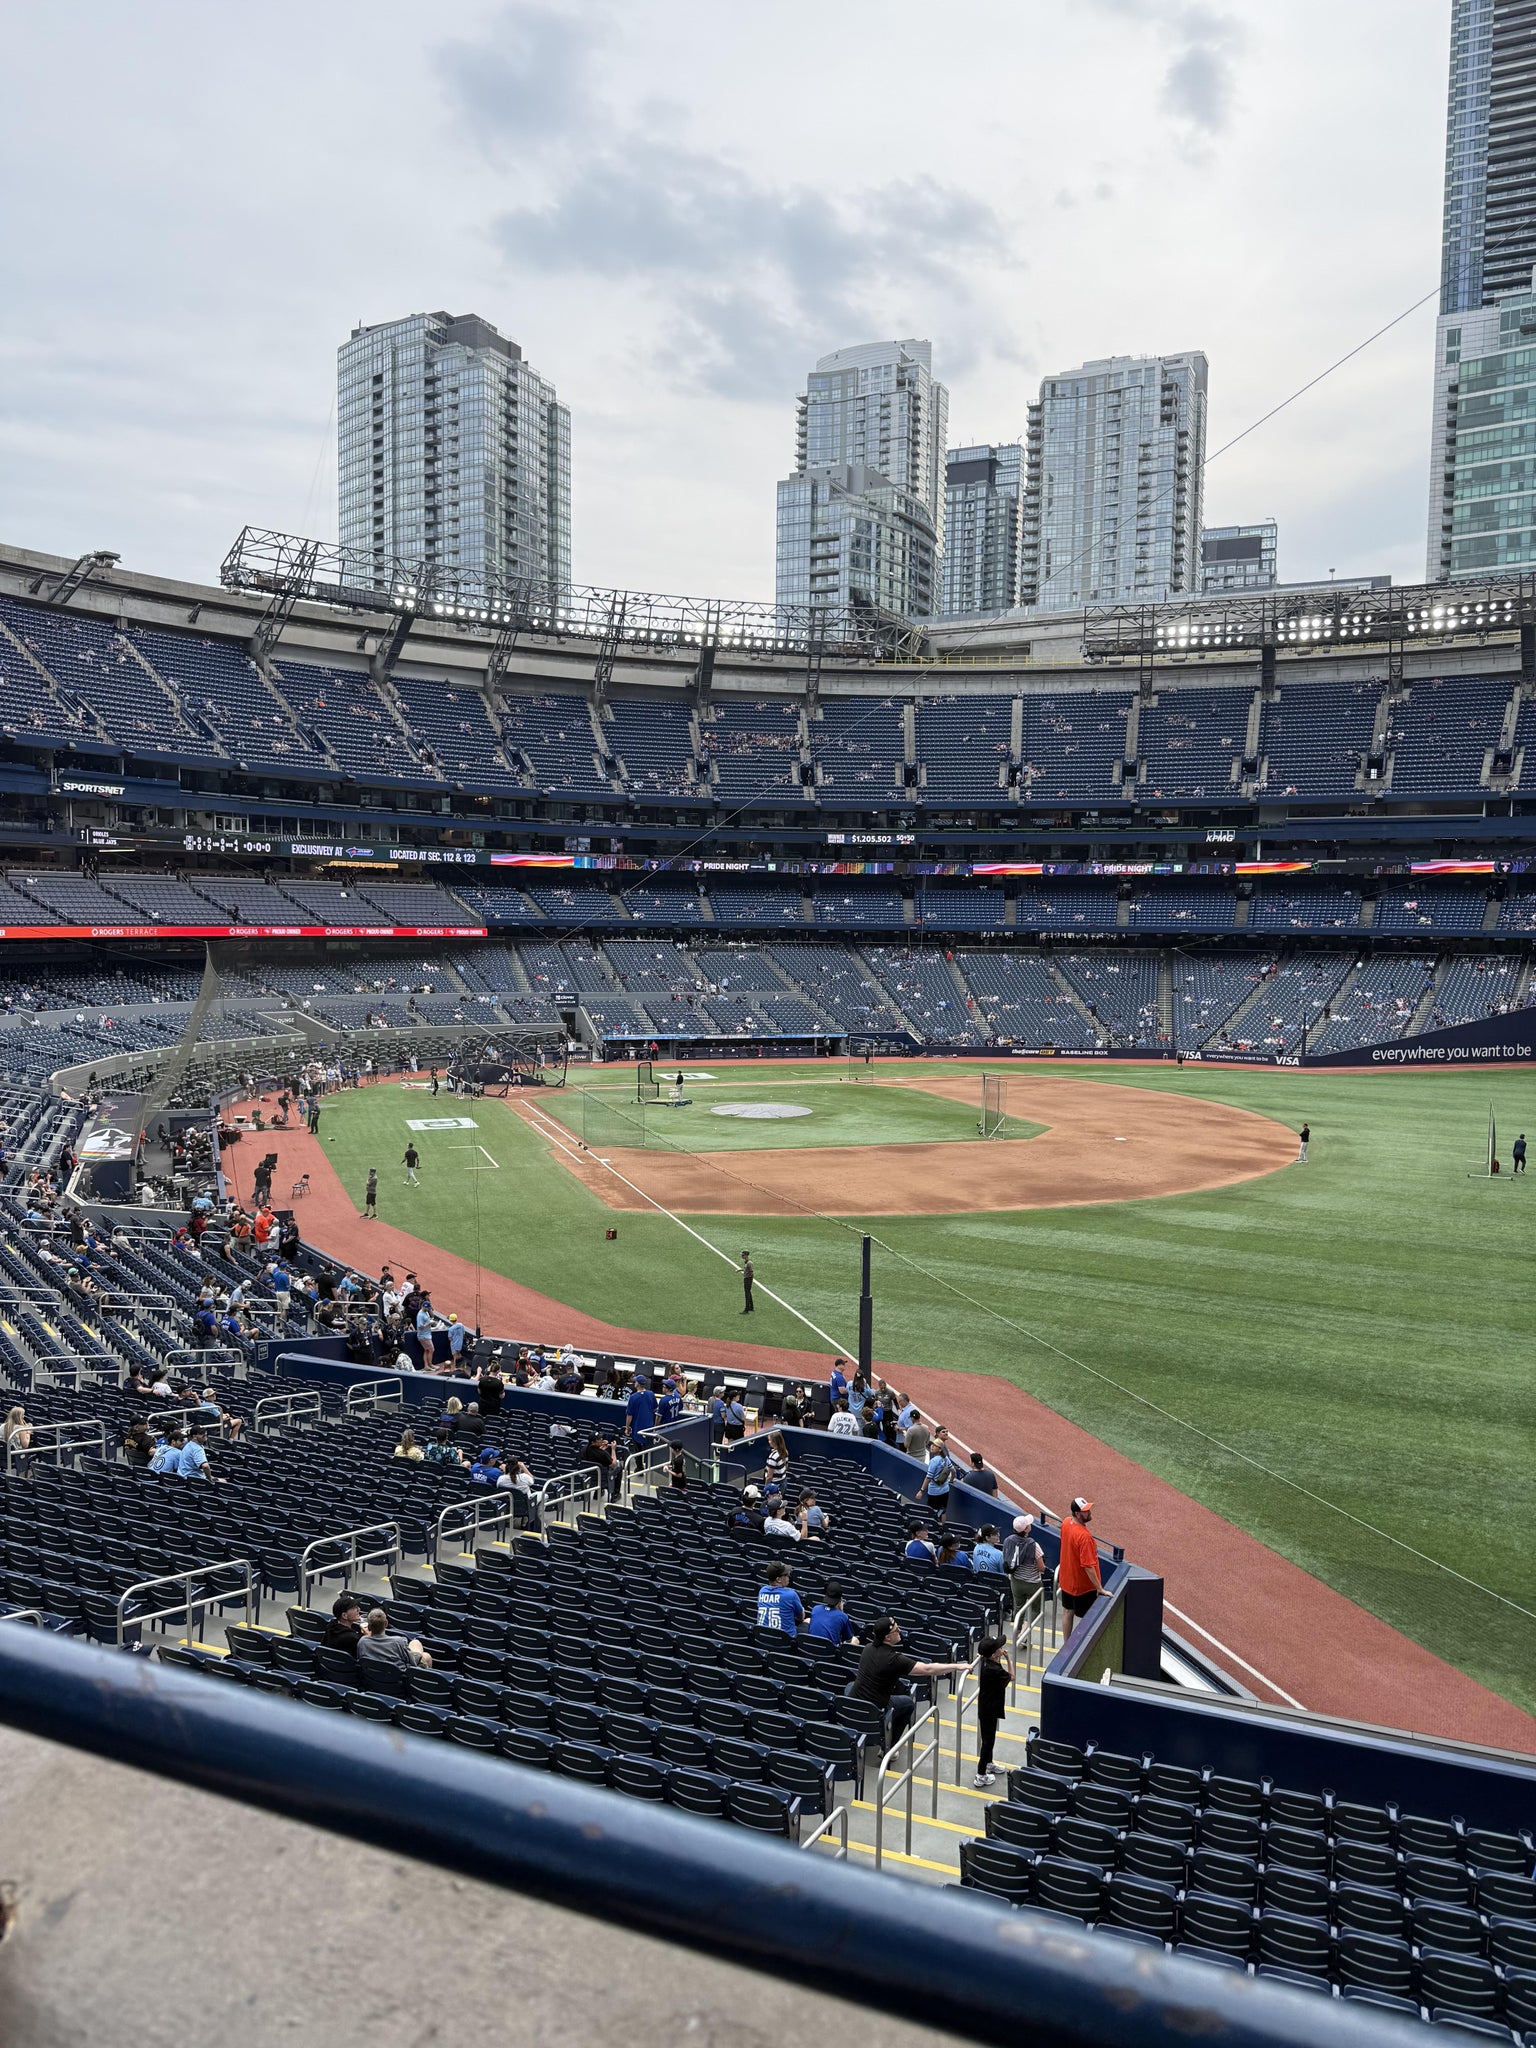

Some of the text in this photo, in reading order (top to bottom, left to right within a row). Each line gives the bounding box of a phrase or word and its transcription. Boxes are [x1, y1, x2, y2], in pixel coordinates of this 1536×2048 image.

[63, 782, 125, 795] SPORTSNET
[1206, 832, 1235, 842] KPMG
[291, 844, 343, 856] EXCLUSIVELY AT
[389, 850, 476, 863] LOCATED AT SEC. 112 & 123
[704, 862, 725, 870] PRIDE
[725, 863, 750, 871] NIGHT
[1103, 864, 1126, 872] PRIDE
[1127, 864, 1153, 872] NIGHT
[1206, 1053, 1234, 1061] everywhere
[1372, 1043, 1532, 1062] everywhere you want to be
[1274, 1055, 1300, 1066] VISA
[669, 1405, 679, 1418] 11
